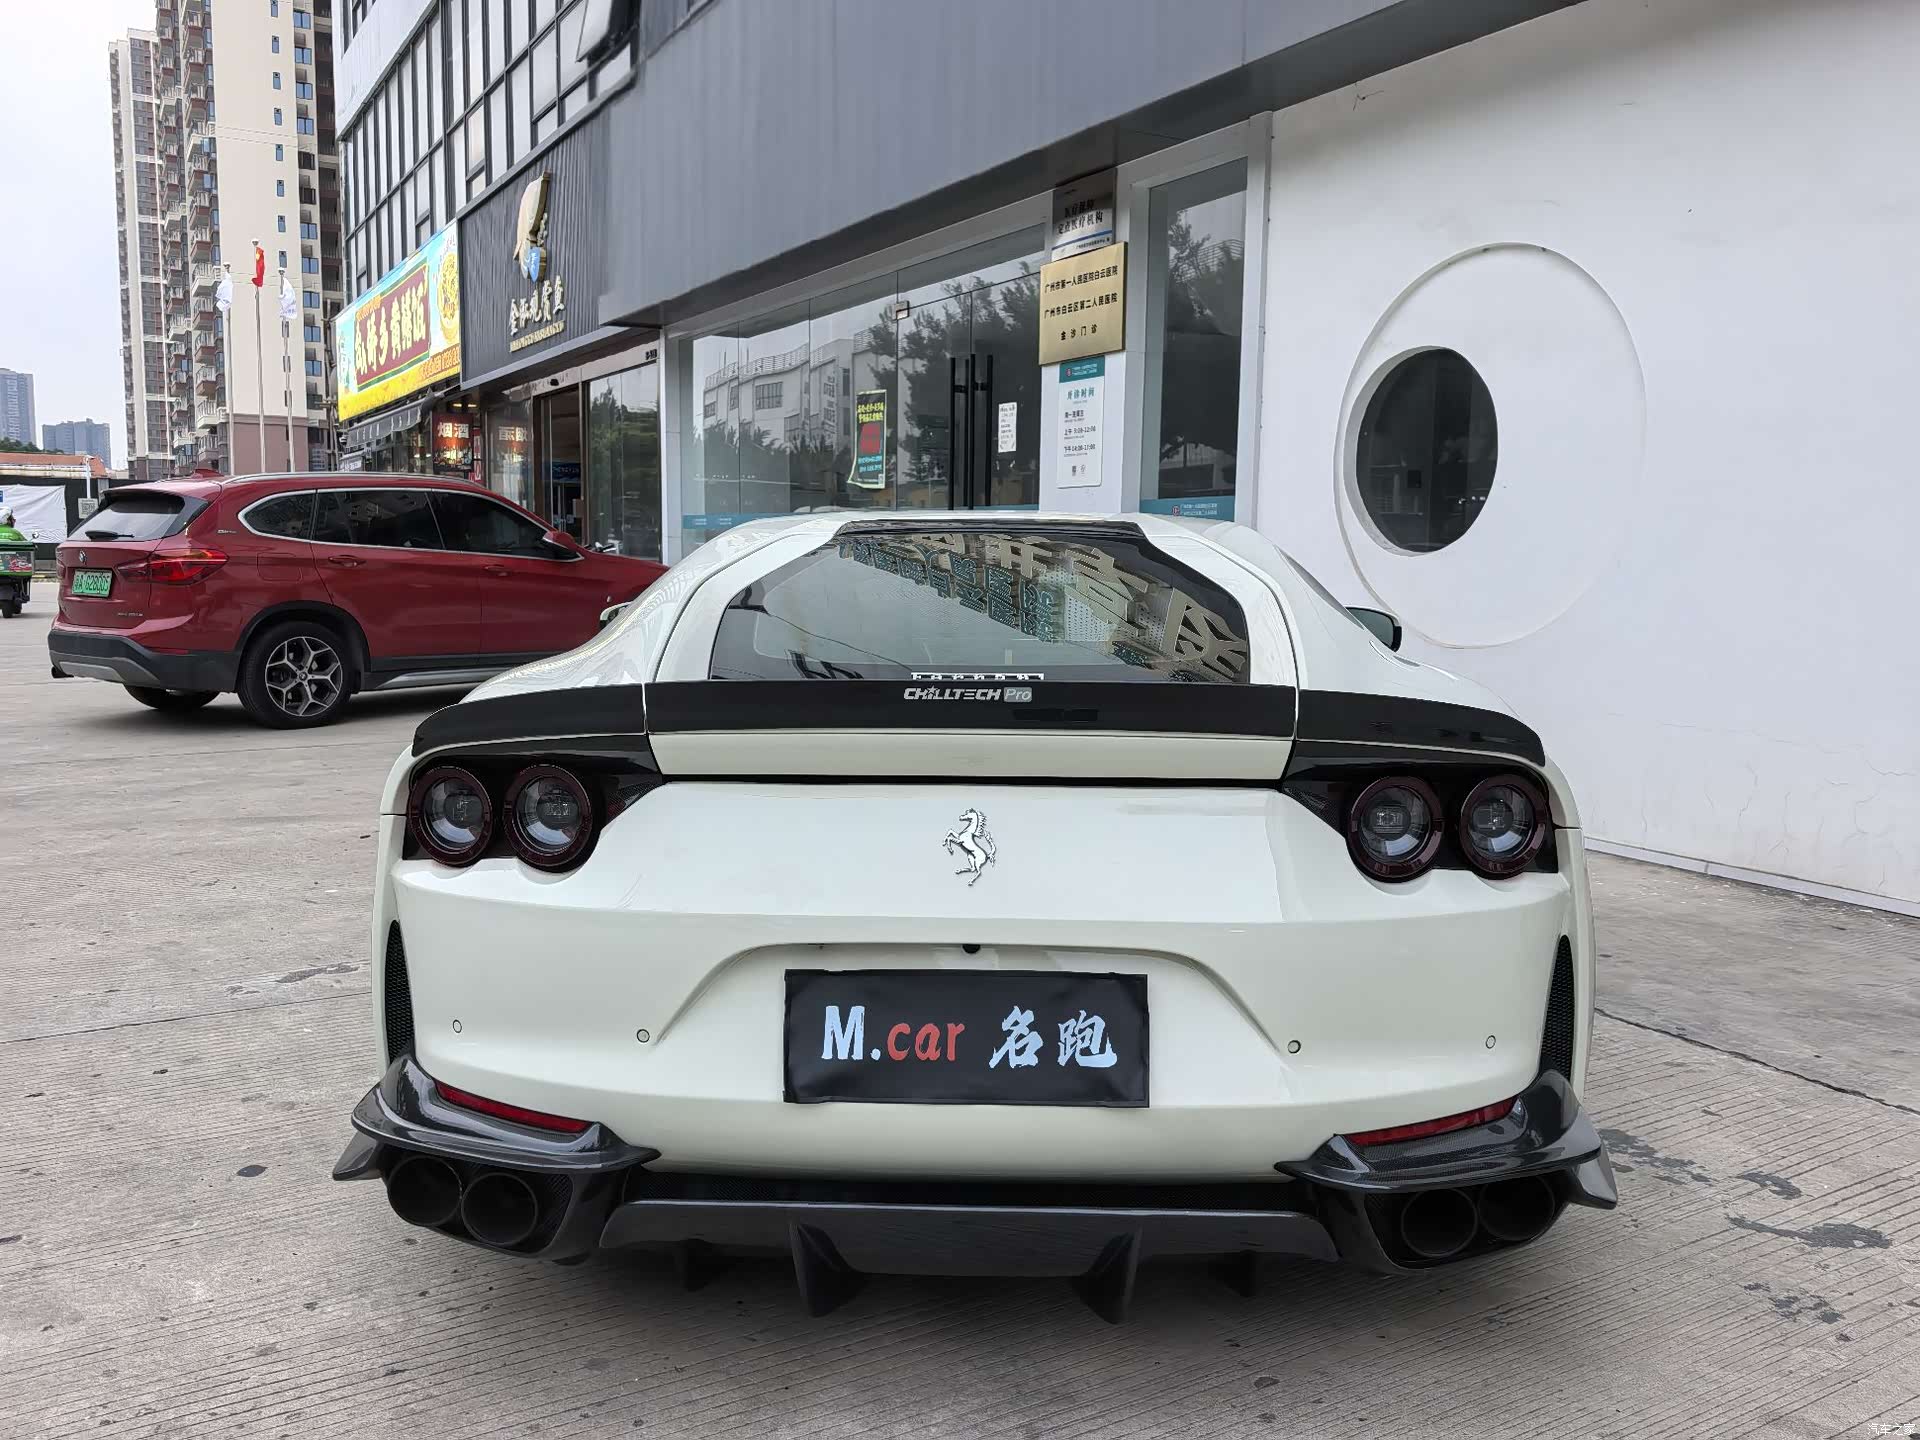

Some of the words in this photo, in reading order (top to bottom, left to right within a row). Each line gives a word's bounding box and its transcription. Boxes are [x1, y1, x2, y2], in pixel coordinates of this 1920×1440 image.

[1044, 265, 1118, 293] 广州市第一人民医院白云医院
[1044, 292, 1118, 319] 广州市白云区第二人民医院
[1060, 324, 1098, 342] 金沙门诊
[437, 421, 470, 439] 烟酒
[1004, 687, 1032, 701] Pro
[821, 1005, 966, 1061] M.car
[989, 1005, 1118, 1069] 名跑
